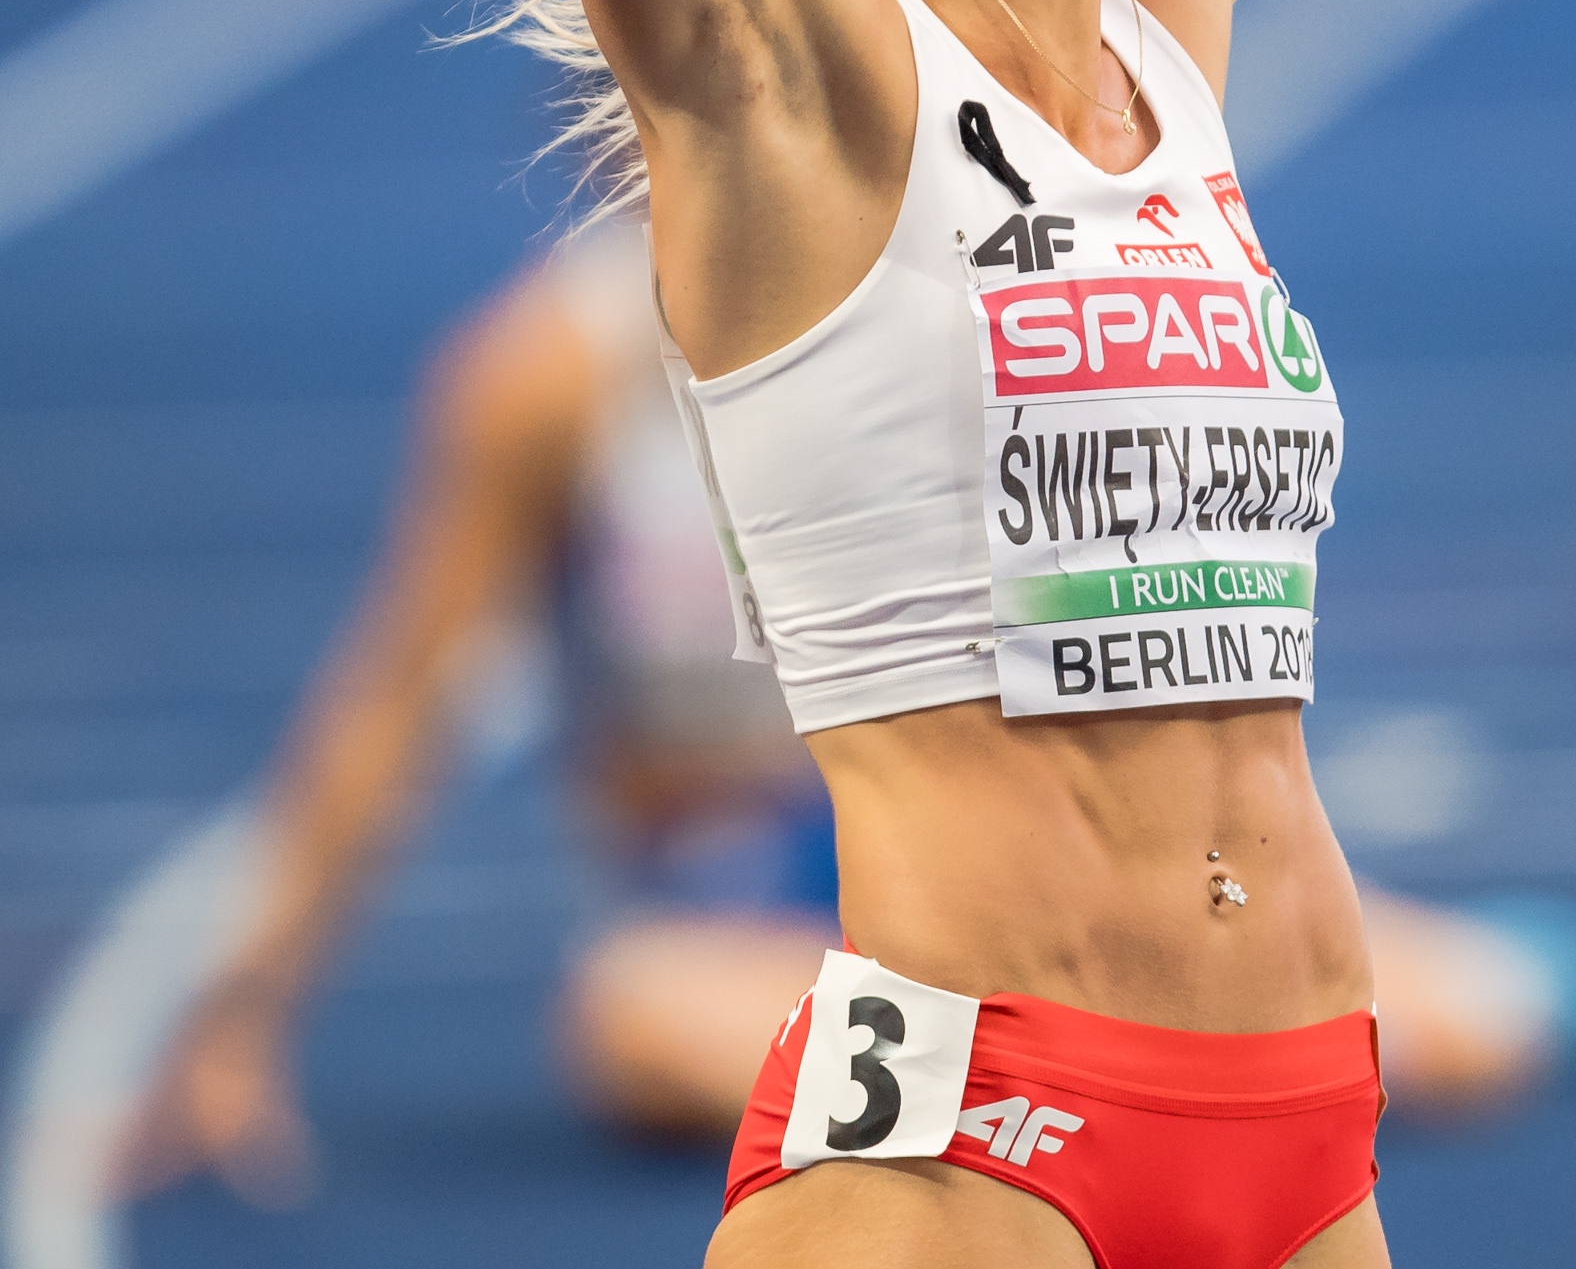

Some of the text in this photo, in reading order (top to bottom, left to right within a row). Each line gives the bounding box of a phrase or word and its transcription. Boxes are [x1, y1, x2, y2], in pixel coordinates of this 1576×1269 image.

[969, 213, 1075, 273] 4F
[1123, 246, 1208, 269] ORLEN
[1001, 292, 1259, 378] SPAR
[1109, 575, 1120, 609] I
[1133, 567, 1207, 606] RUN
[1052, 624, 1253, 696] BERLIN
[826, 996, 906, 1152] 3
[956, 1095, 1085, 1168] 4F
